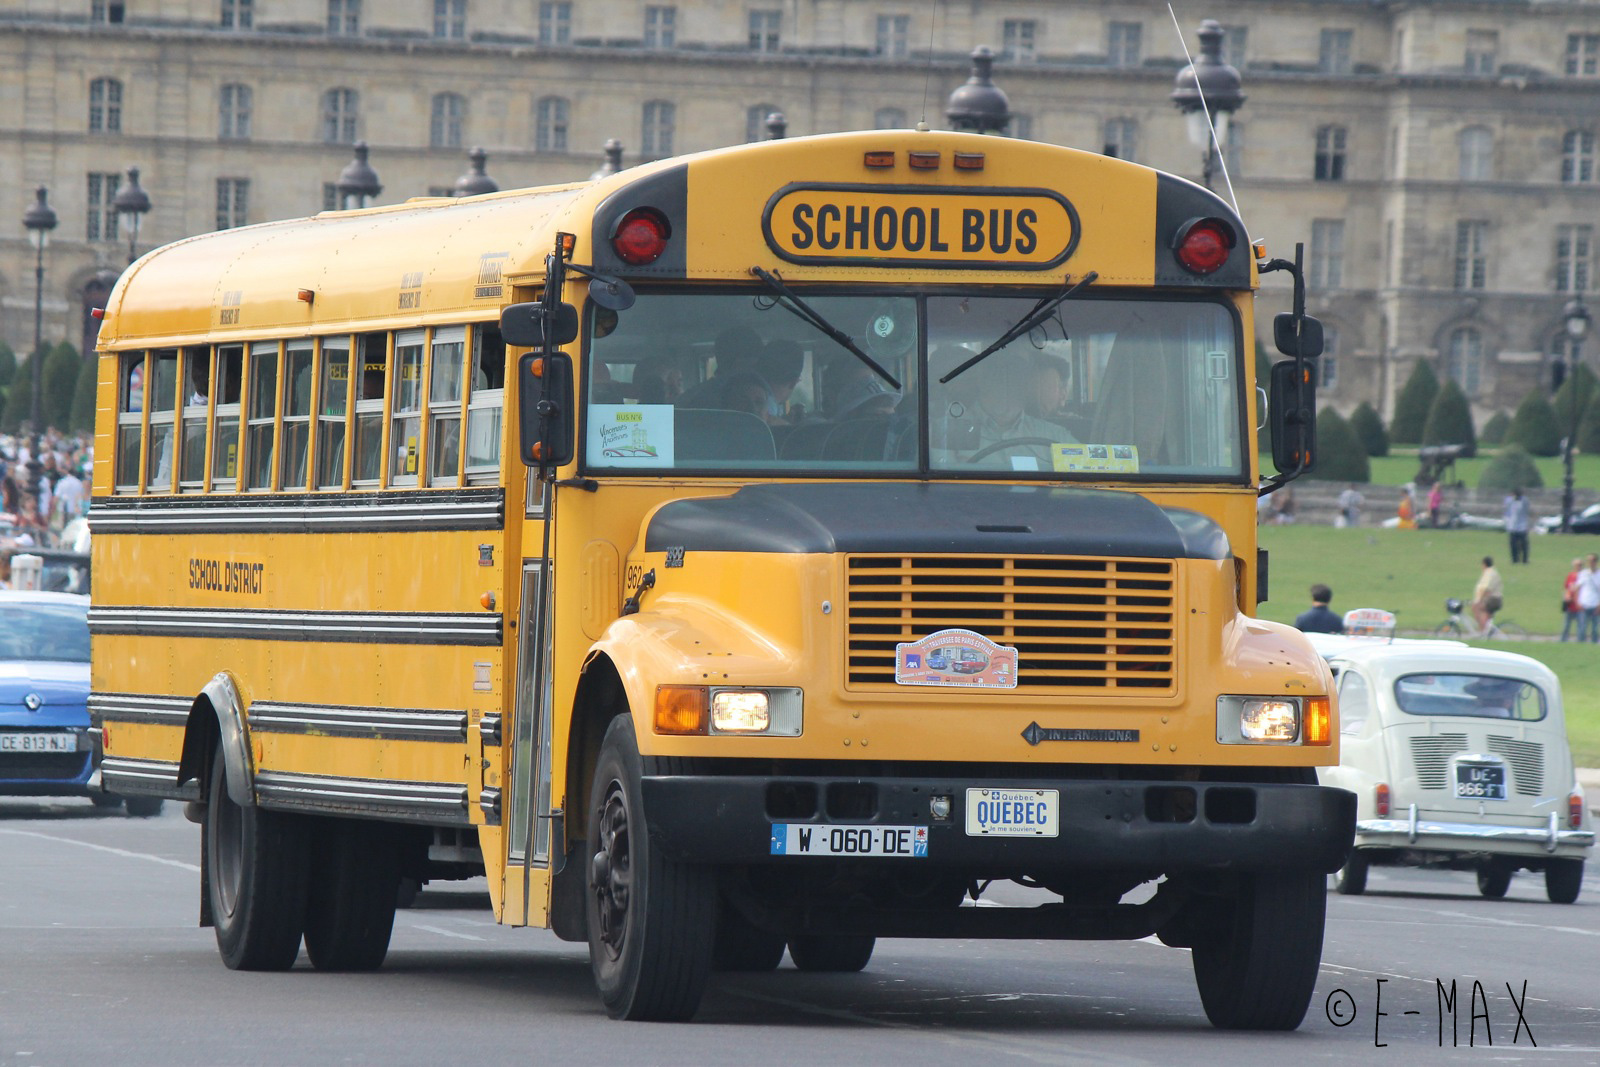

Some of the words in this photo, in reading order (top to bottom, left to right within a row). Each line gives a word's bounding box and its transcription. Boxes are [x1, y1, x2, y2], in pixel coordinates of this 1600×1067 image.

[791, 203, 949, 253] SCHOOL
[961, 207, 1038, 255] BUS
[189, 558, 223, 591] SCHOOL
[225, 561, 264, 594] DISTRICT
[627, 565, 643, 589] 962
[1001, 793, 1035, 801] Québec
[977, 801, 1048, 828] QUEBEC
[776, 841, 781, 850] F
[914, 842, 928, 855] 77
